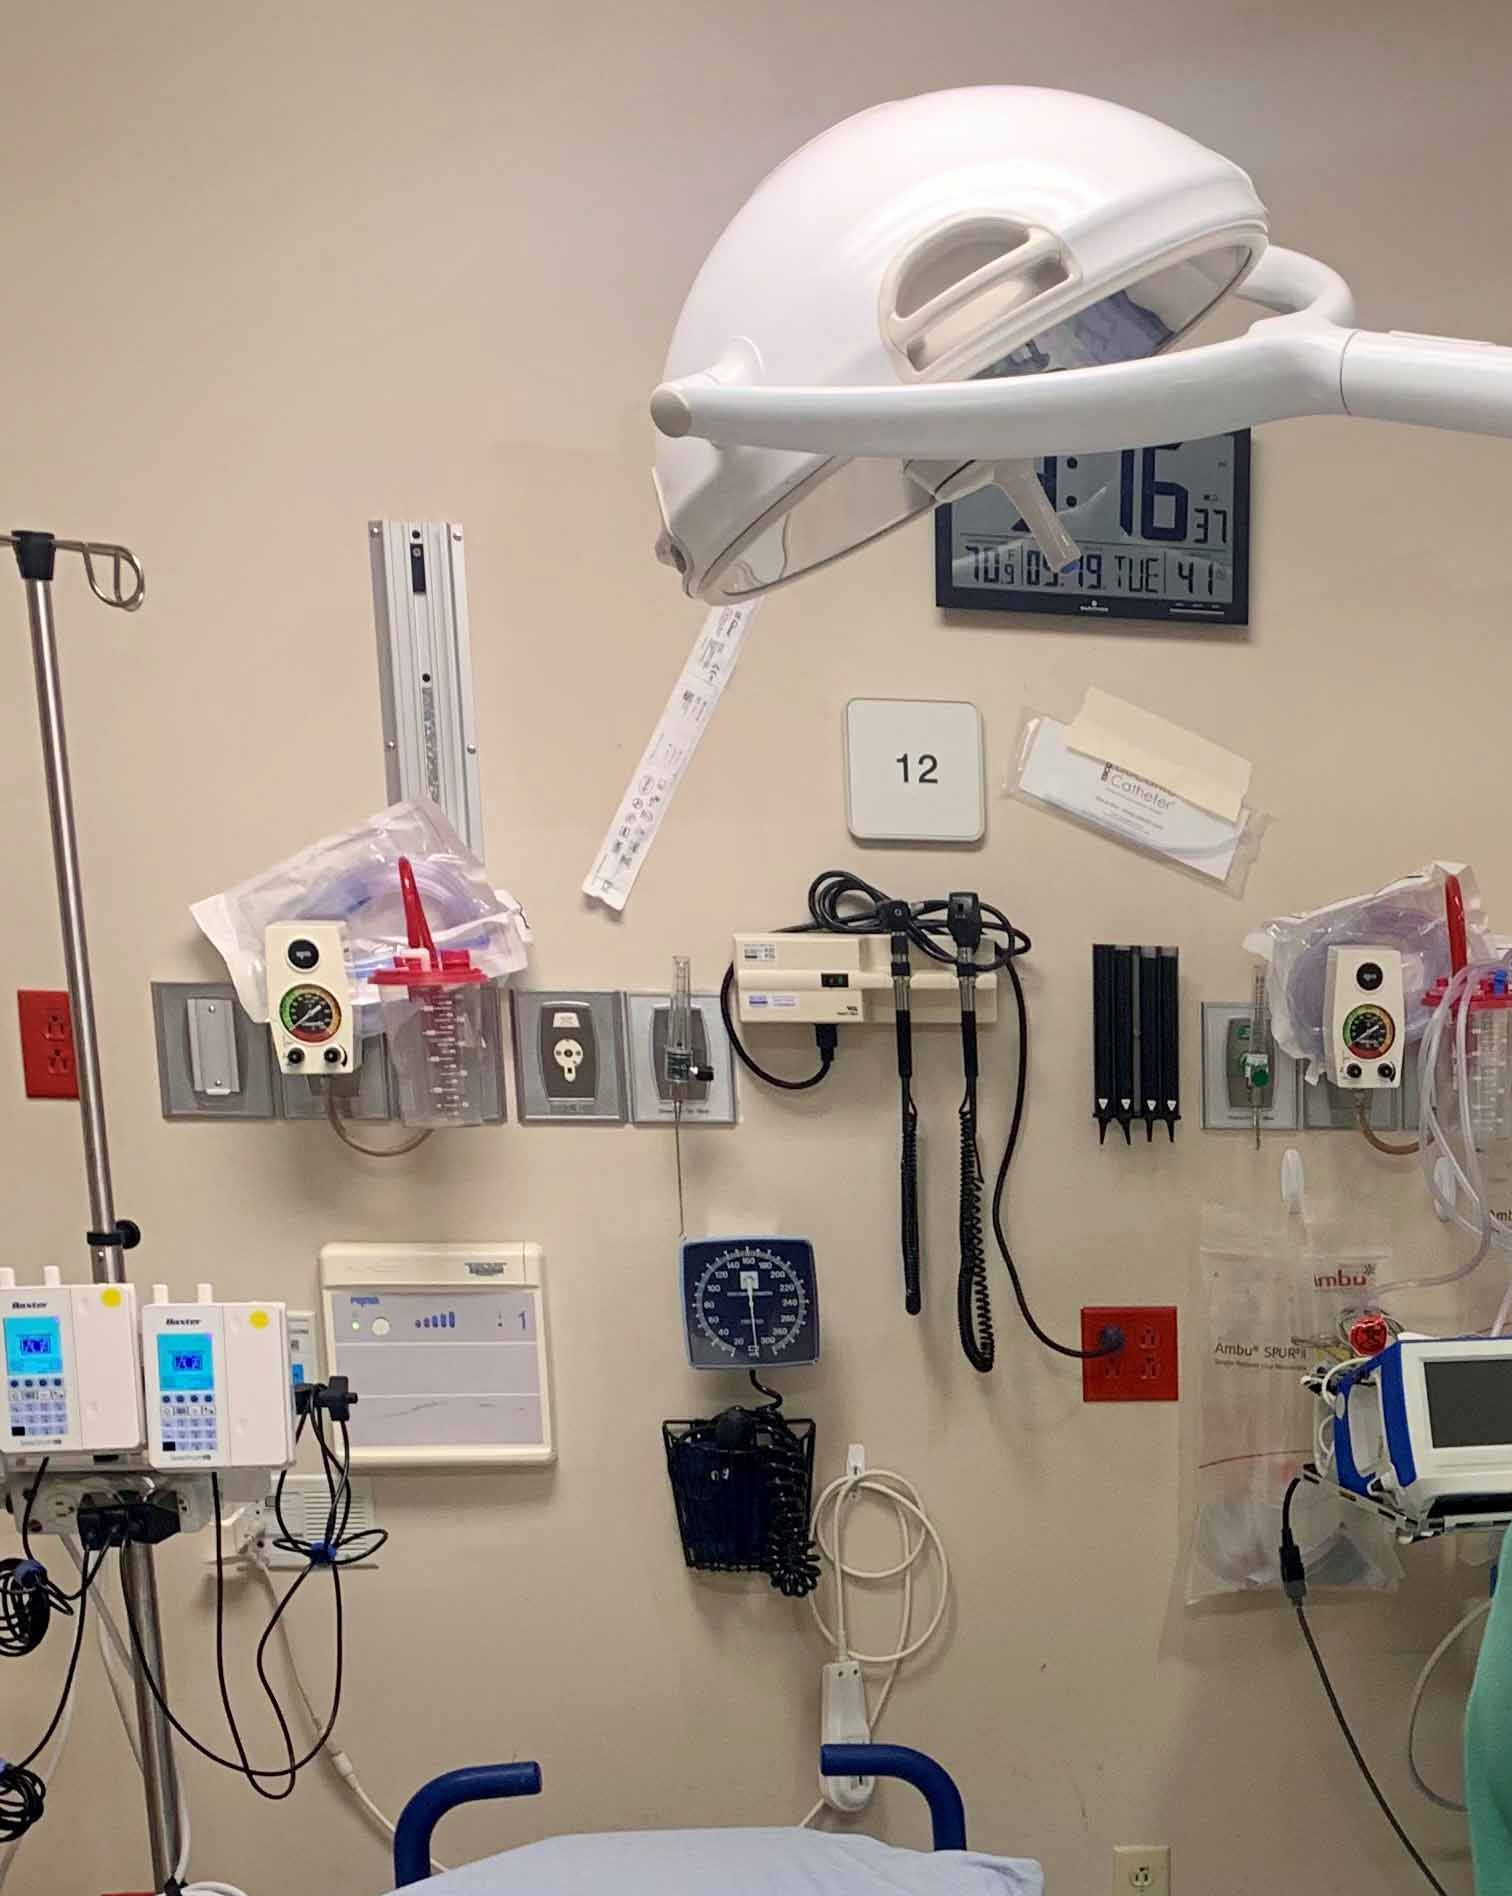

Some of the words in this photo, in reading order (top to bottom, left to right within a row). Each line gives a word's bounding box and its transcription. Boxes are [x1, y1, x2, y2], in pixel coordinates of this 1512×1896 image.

[1193, 507, 1227, 544] 37
[1114, 555, 1159, 594] TUE
[1177, 560, 1214, 596] 41
[896, 753, 938, 784] 12
[518, 1311, 528, 1331] 1
